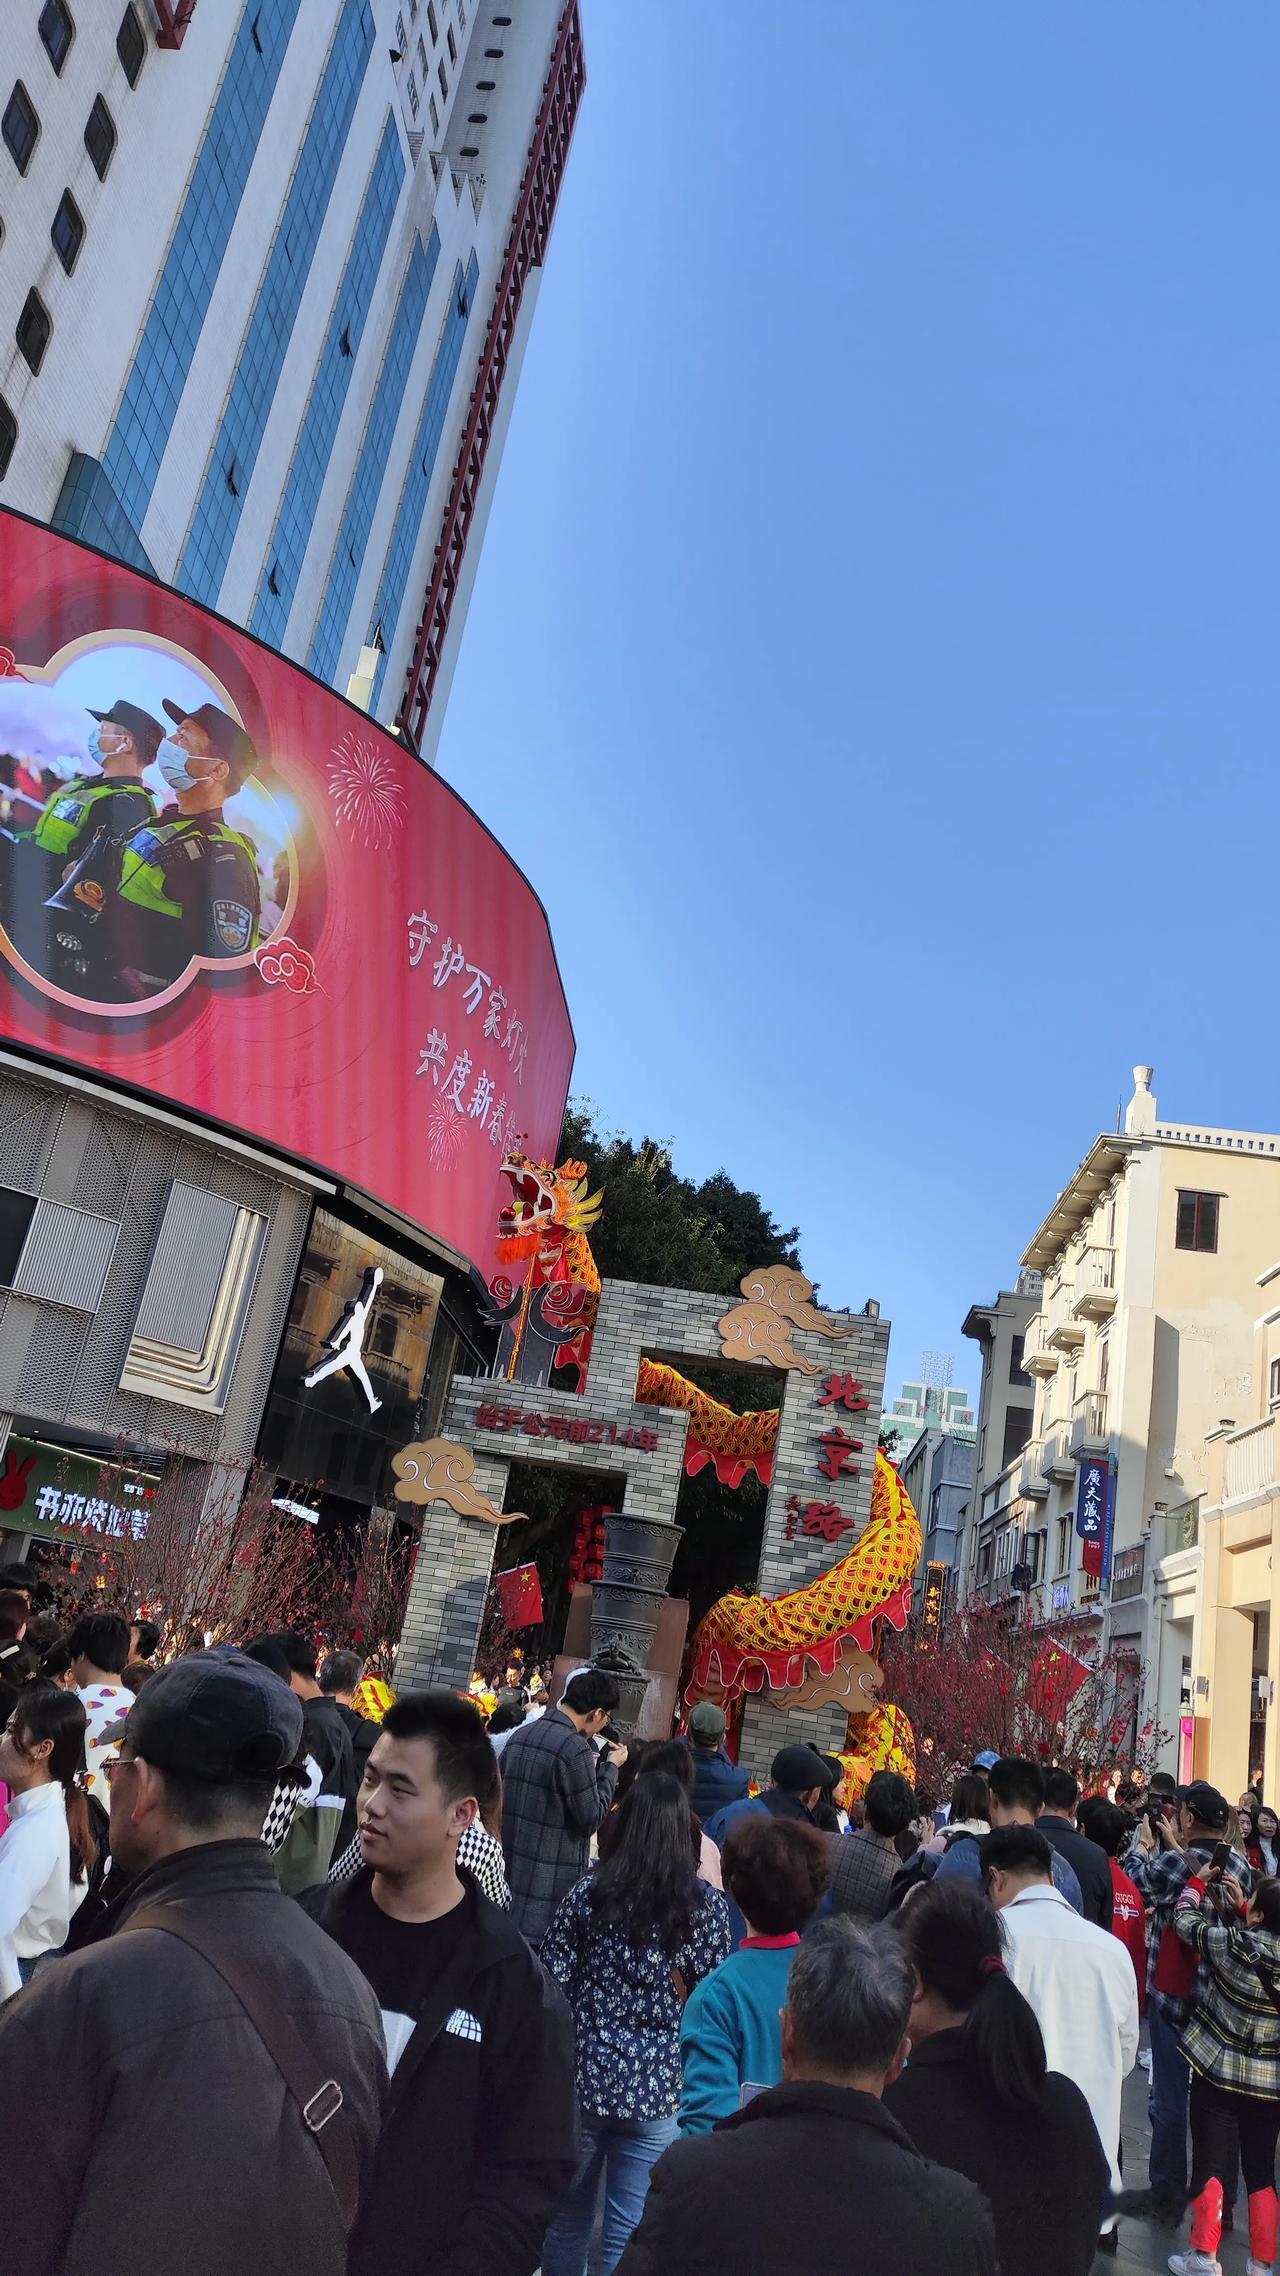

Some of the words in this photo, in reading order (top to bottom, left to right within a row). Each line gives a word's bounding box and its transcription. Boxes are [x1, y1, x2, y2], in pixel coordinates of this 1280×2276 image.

[475, 1403, 660, 1453] 始于公元前214年
[802, 1372, 870, 1542] 北京路
[1083, 1468, 1102, 1532] 廣天藏品
